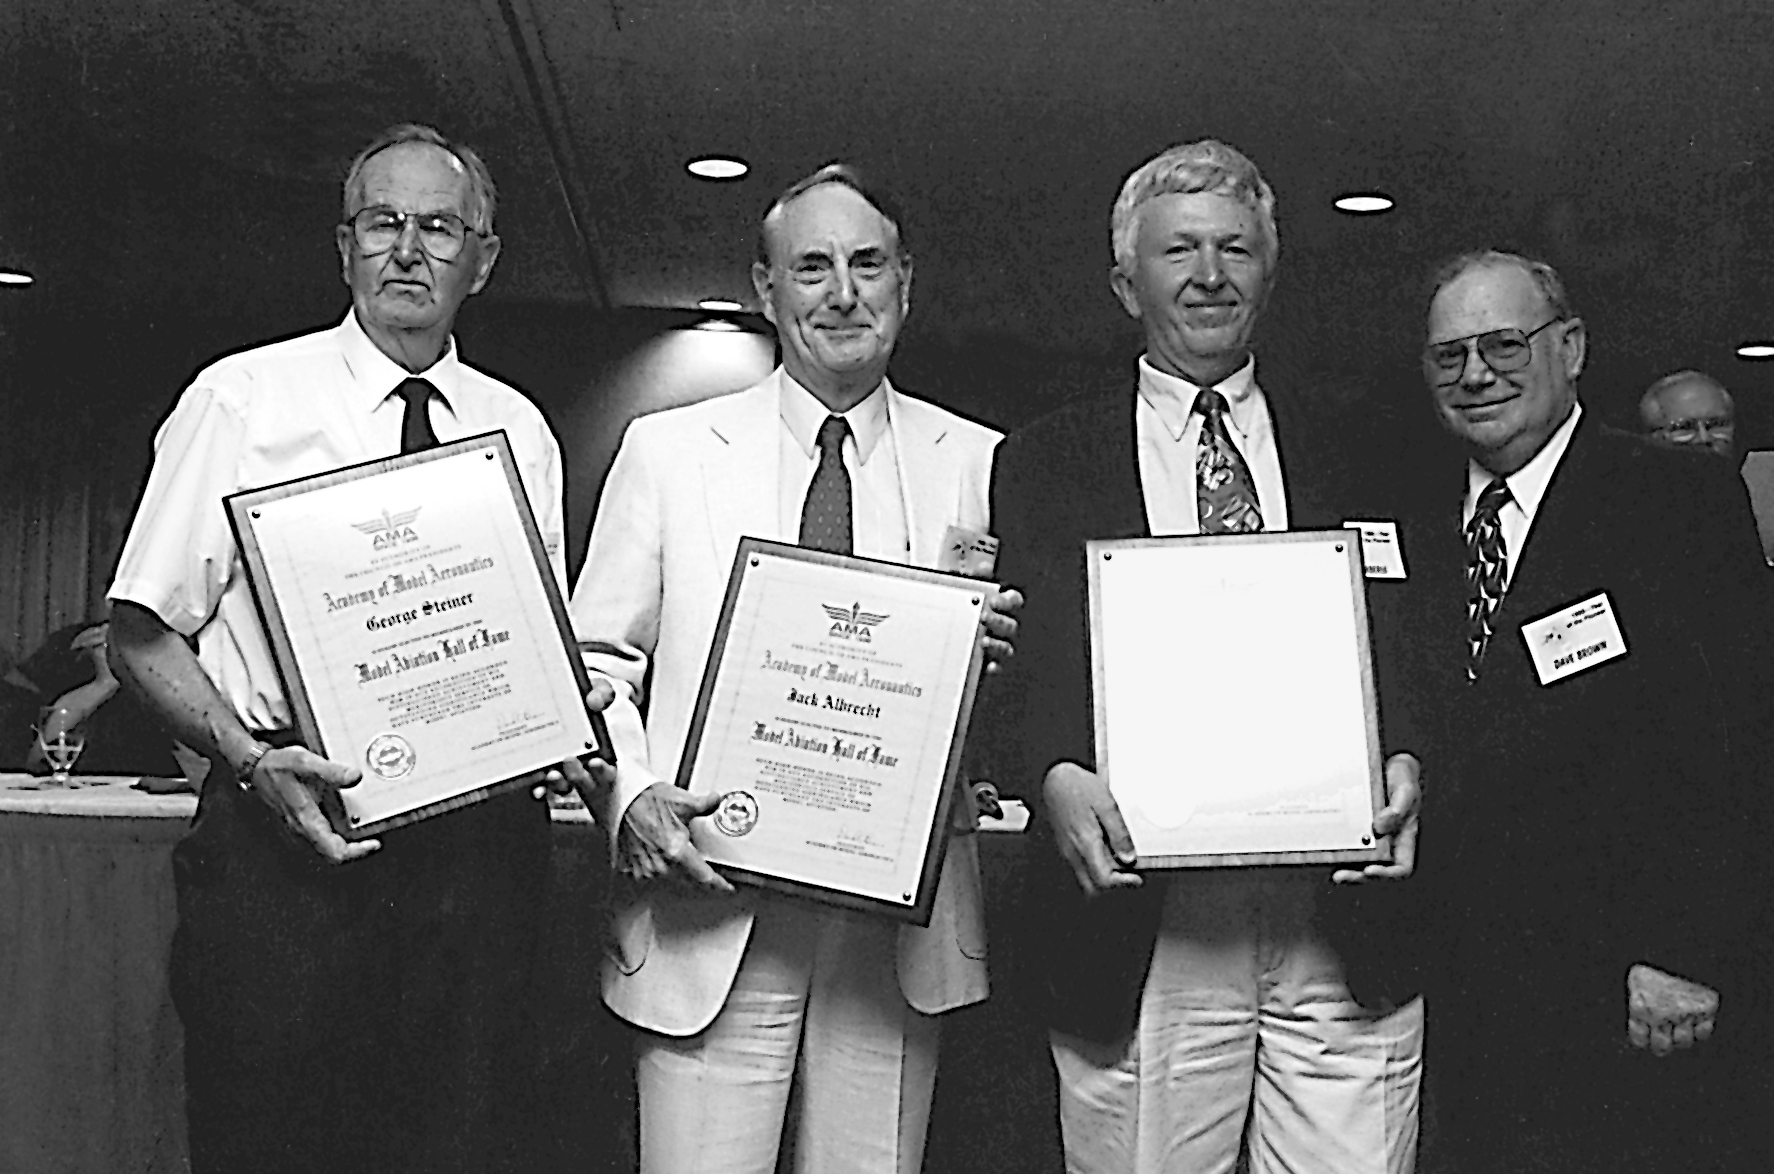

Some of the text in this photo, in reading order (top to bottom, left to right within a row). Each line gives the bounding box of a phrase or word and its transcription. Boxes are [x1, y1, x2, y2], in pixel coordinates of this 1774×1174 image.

[373, 526, 417, 546] AMA
[377, 581, 390, 595] of
[366, 593, 473, 632] George Steiner
[831, 622, 871, 637] AMA
[468, 635, 479, 651] of
[1554, 641, 1607, 670] DAVE BROWN
[809, 663, 823, 678] of
[787, 687, 881, 718] Jack Albrecht
[856, 747, 869, 762] of
